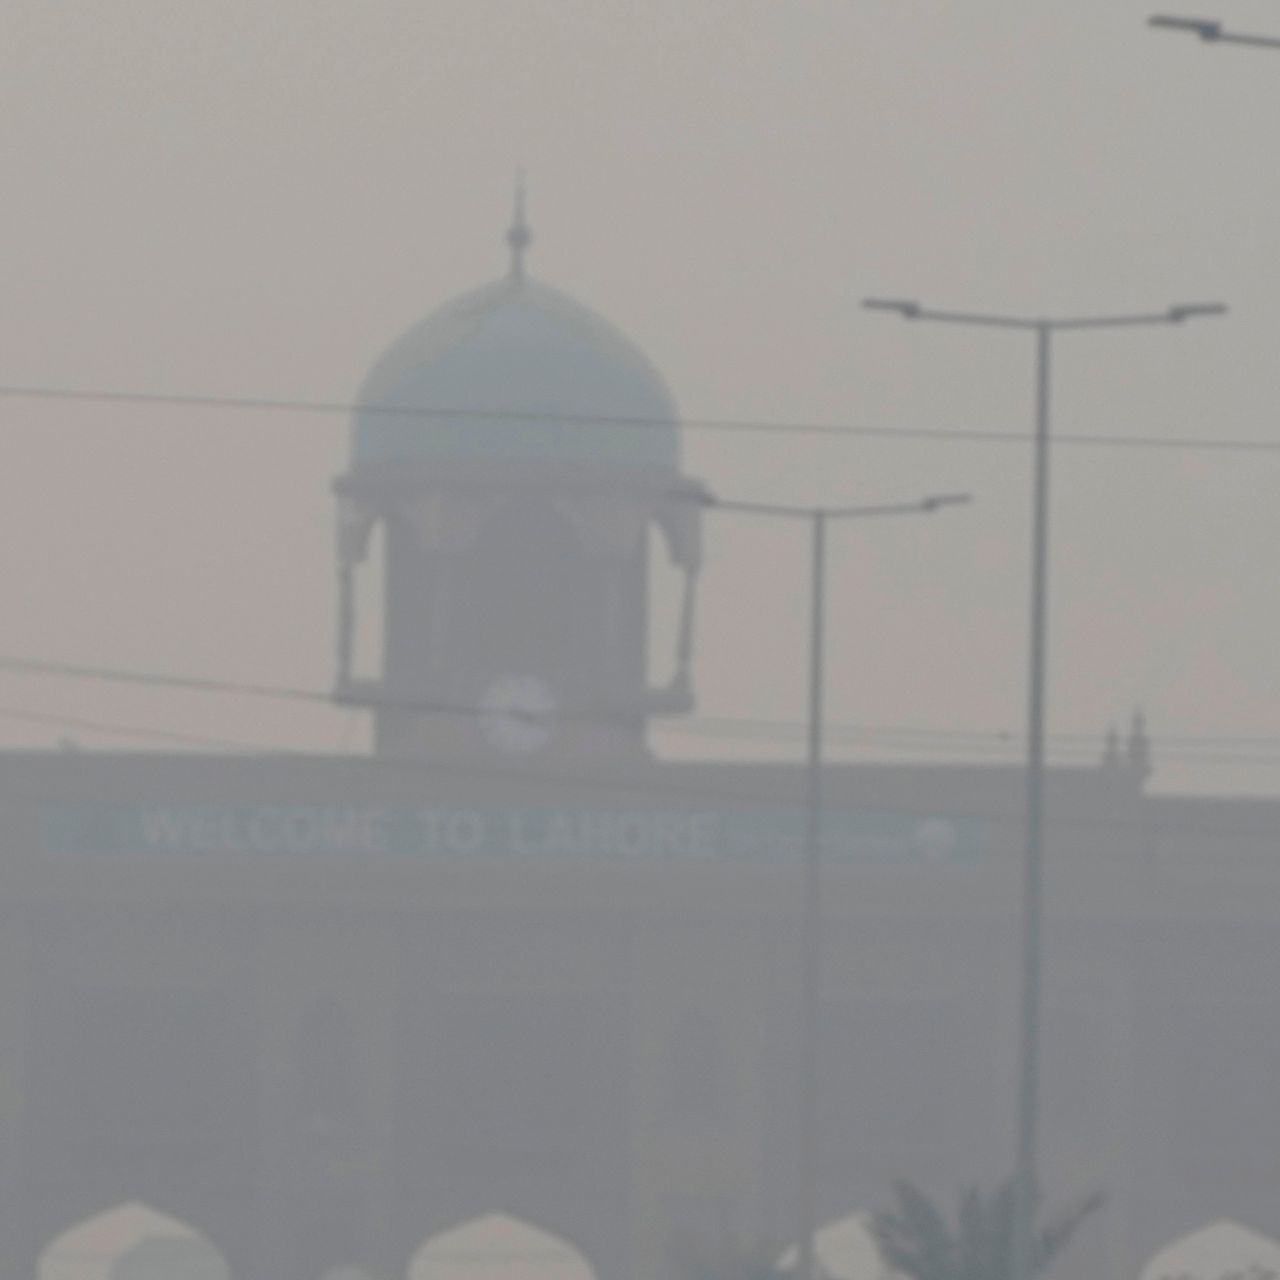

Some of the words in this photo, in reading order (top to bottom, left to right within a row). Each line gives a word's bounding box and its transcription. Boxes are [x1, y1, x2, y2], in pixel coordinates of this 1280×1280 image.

[140, 805, 389, 852] WELCOME
[415, 808, 486, 852] TO
[509, 810, 720, 857] LAHORE
